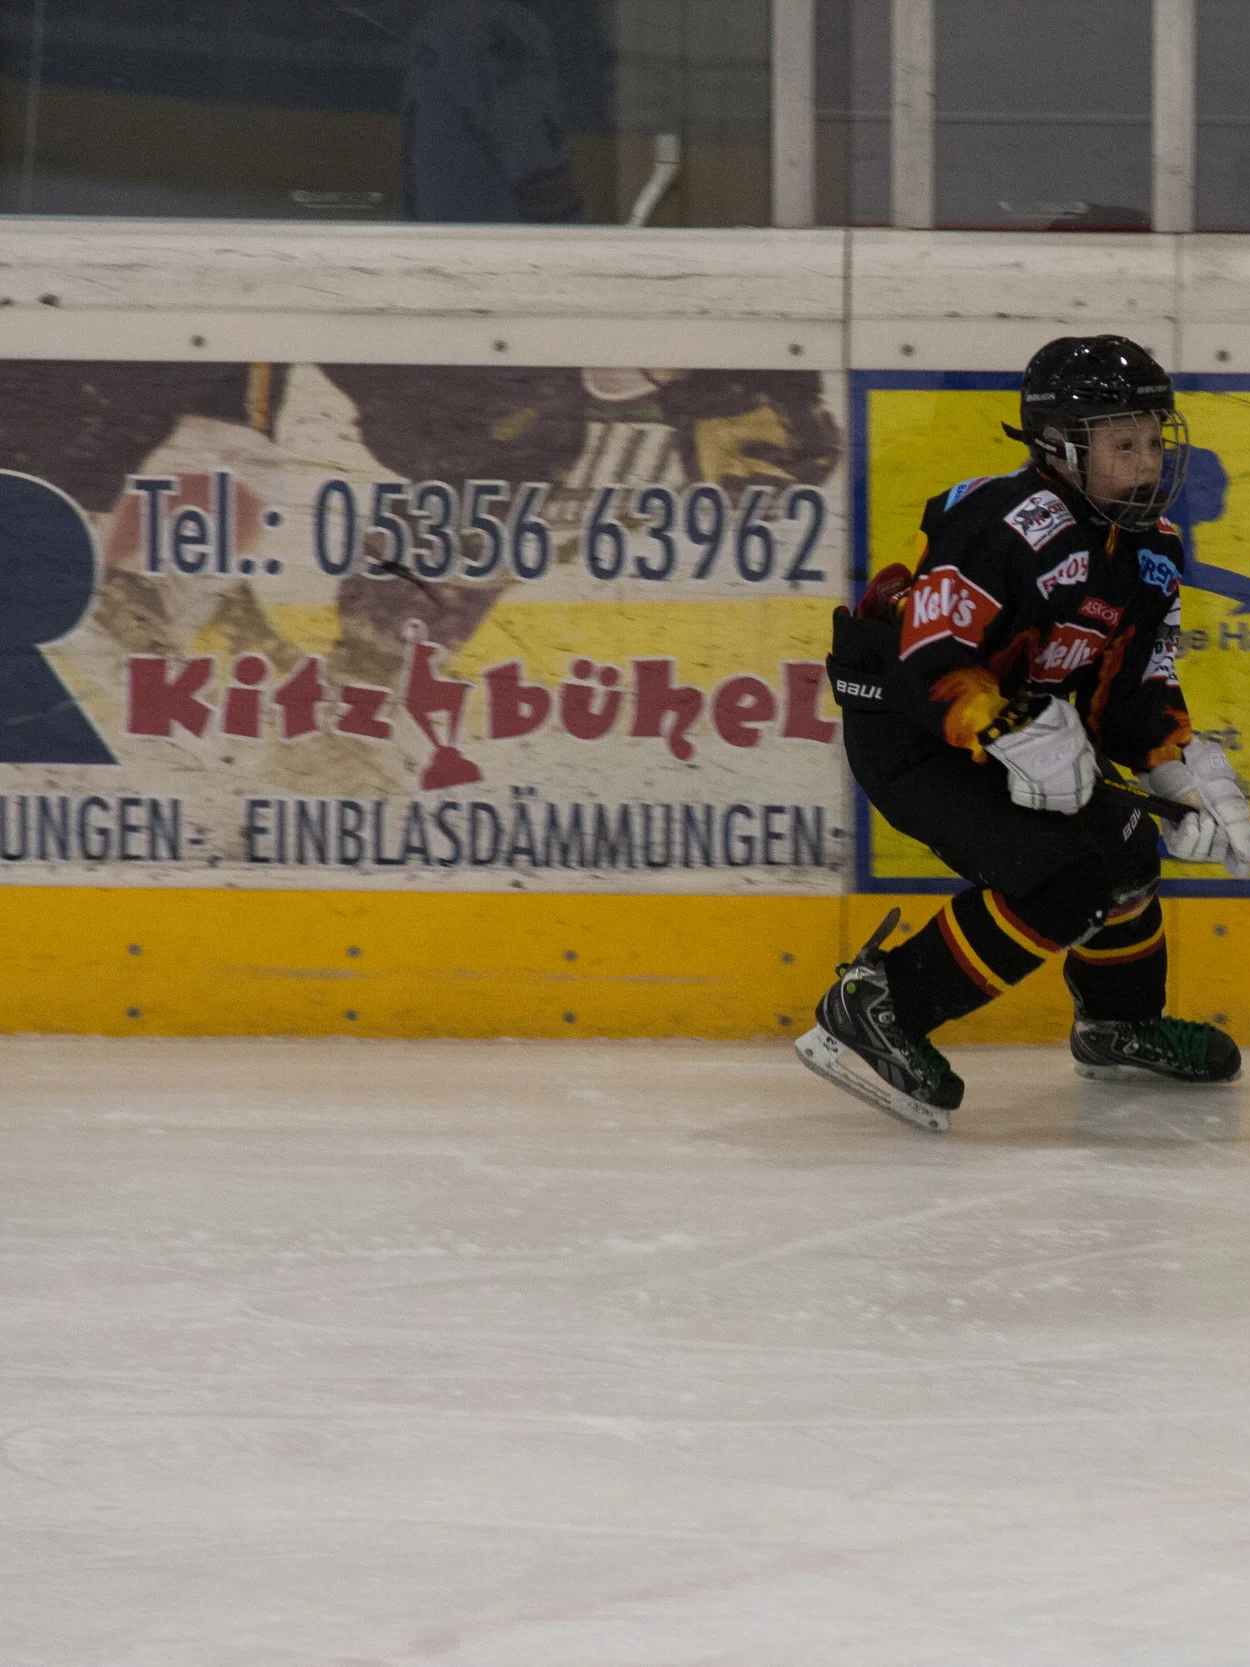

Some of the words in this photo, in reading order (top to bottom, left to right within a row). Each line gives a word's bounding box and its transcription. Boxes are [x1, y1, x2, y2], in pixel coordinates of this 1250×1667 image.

[131, 472, 284, 576] Tel.:
[314, 480, 552, 581] 05356
[582, 485, 827, 583] 63962
